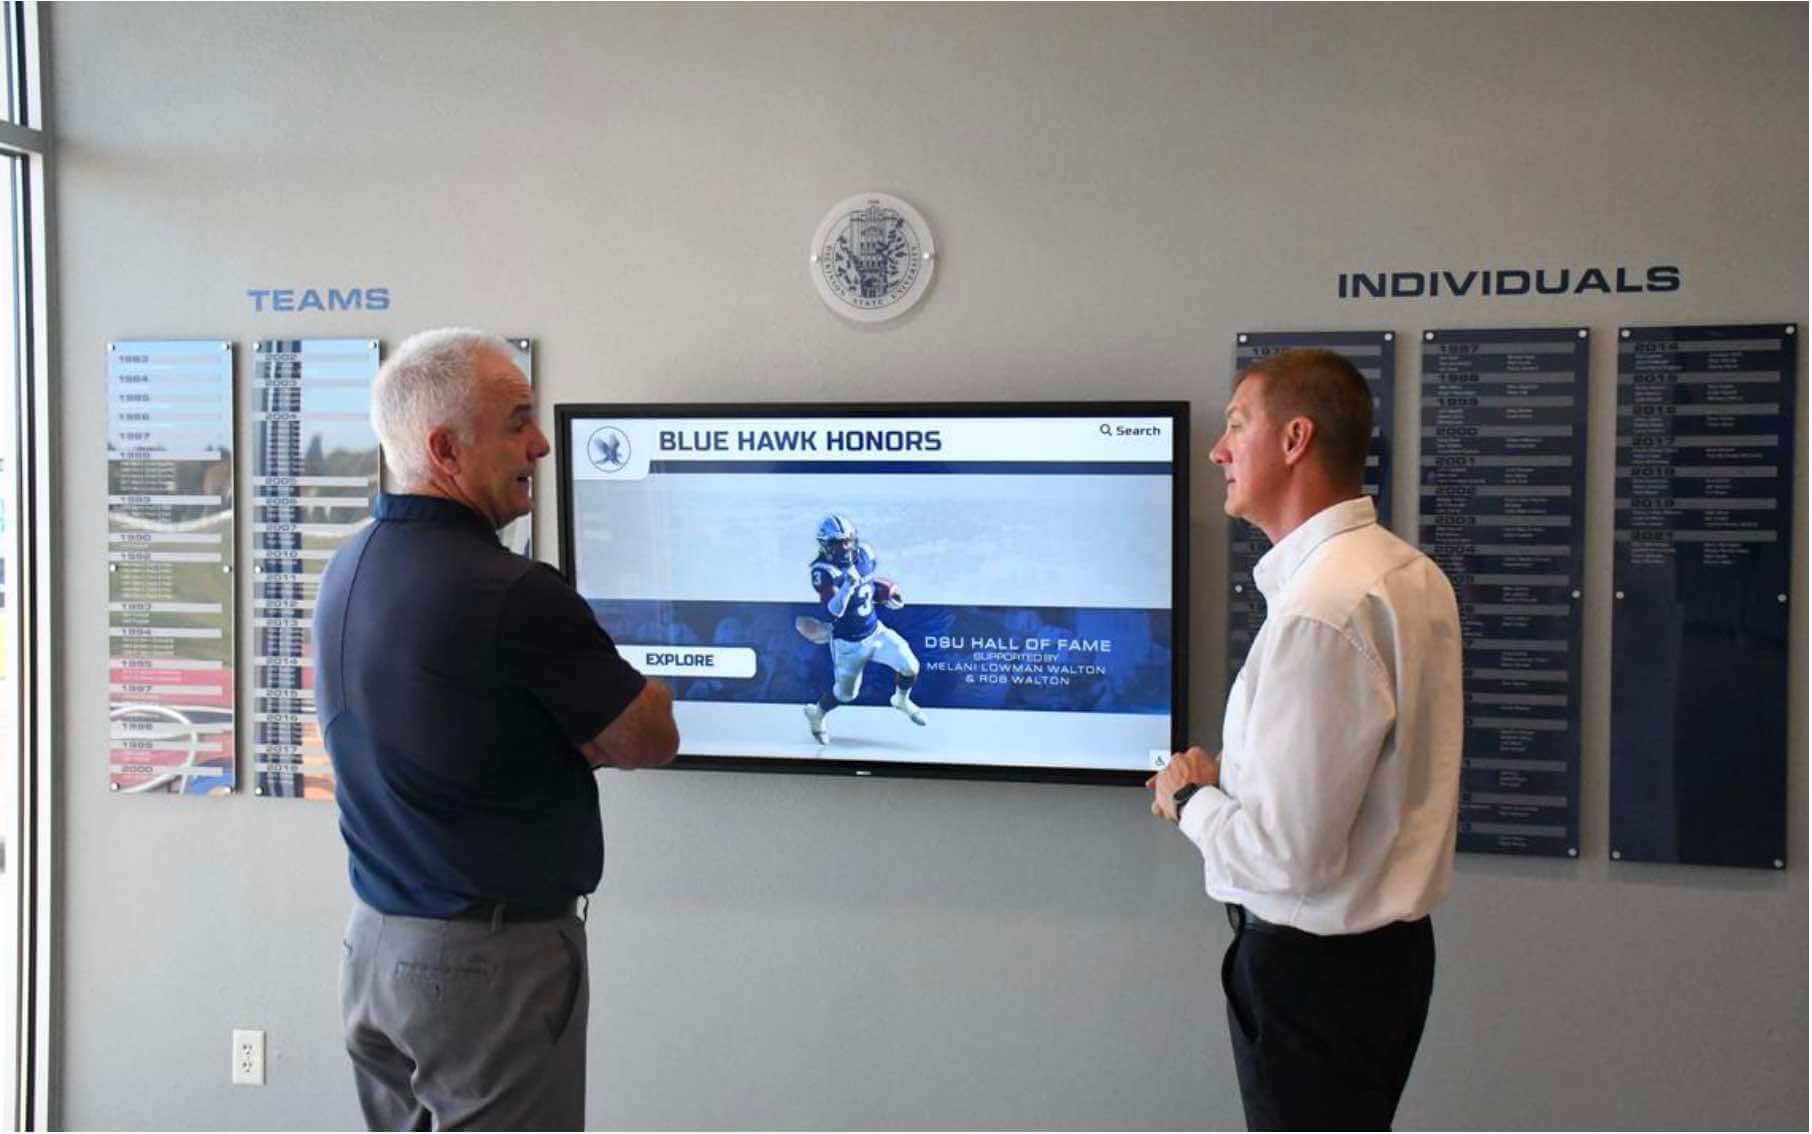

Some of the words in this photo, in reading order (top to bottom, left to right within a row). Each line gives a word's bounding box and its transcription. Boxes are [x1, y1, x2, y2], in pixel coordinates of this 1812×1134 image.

[1338, 265, 1681, 298] INDIVIDUALS
[247, 289, 391, 311] TEAMS
[1116, 425, 1161, 436] Search
[659, 431, 729, 451] BLUE
[738, 431, 817, 451] HAWK
[826, 430, 942, 451] HONORS
[266, 550, 298, 558] 2010
[857, 584, 873, 617] 3
[925, 636, 964, 649] DSU
[971, 637, 1020, 650] HALL
[1025, 638, 1051, 651] OF
[1058, 639, 1112, 652] FAME
[645, 653, 715, 668] EXPLORE
[973, 652, 1042, 662] SUPPORTED
[1043, 653, 1060, 662] BY
[926, 662, 977, 672] MELANI
[982, 663, 1044, 673] LOWMAN
[1047, 665, 1106, 674] WALTON
[980, 676, 1008, 684] ROB
[1012, 676, 1070, 686] WALTON
